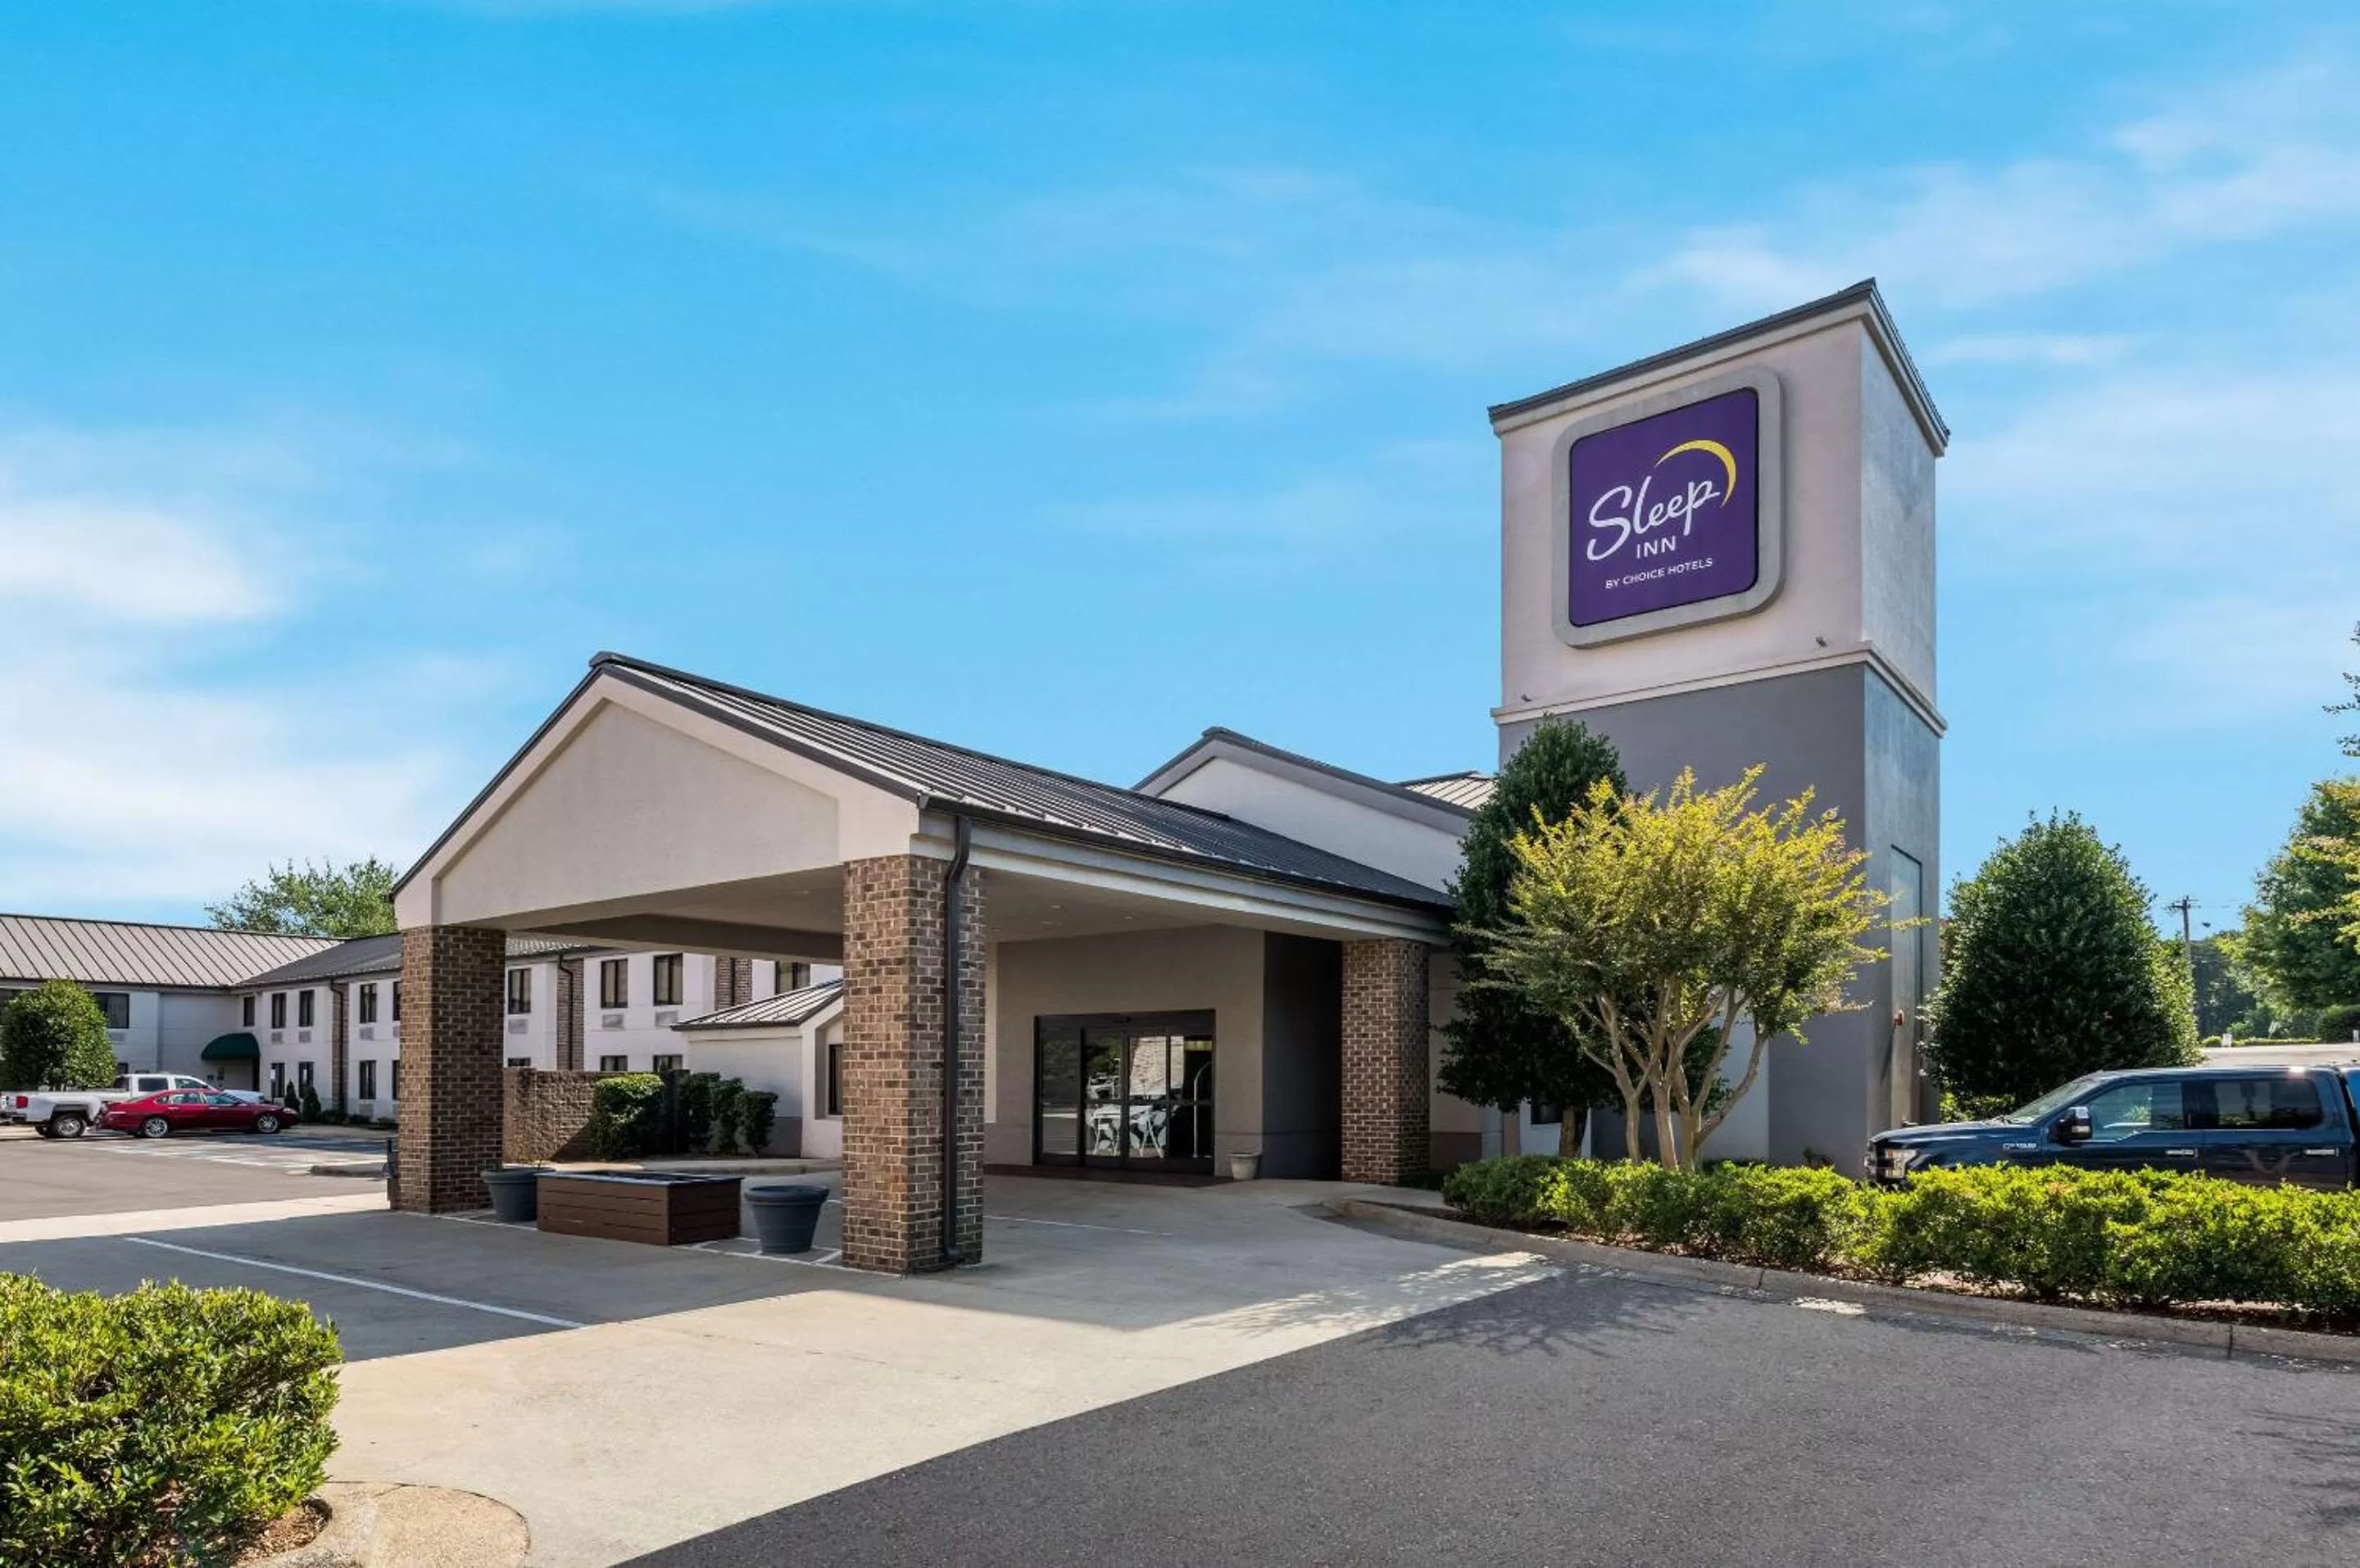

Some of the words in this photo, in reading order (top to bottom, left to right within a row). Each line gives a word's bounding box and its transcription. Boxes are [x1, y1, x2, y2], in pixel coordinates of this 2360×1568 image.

[1586, 475, 1721, 561] Sleep
[1636, 535, 1677, 559] INN
[1605, 578, 1620, 589] BY
[1622, 567, 1666, 585] CHOICE
[1668, 557, 1713, 575] HOTELS
